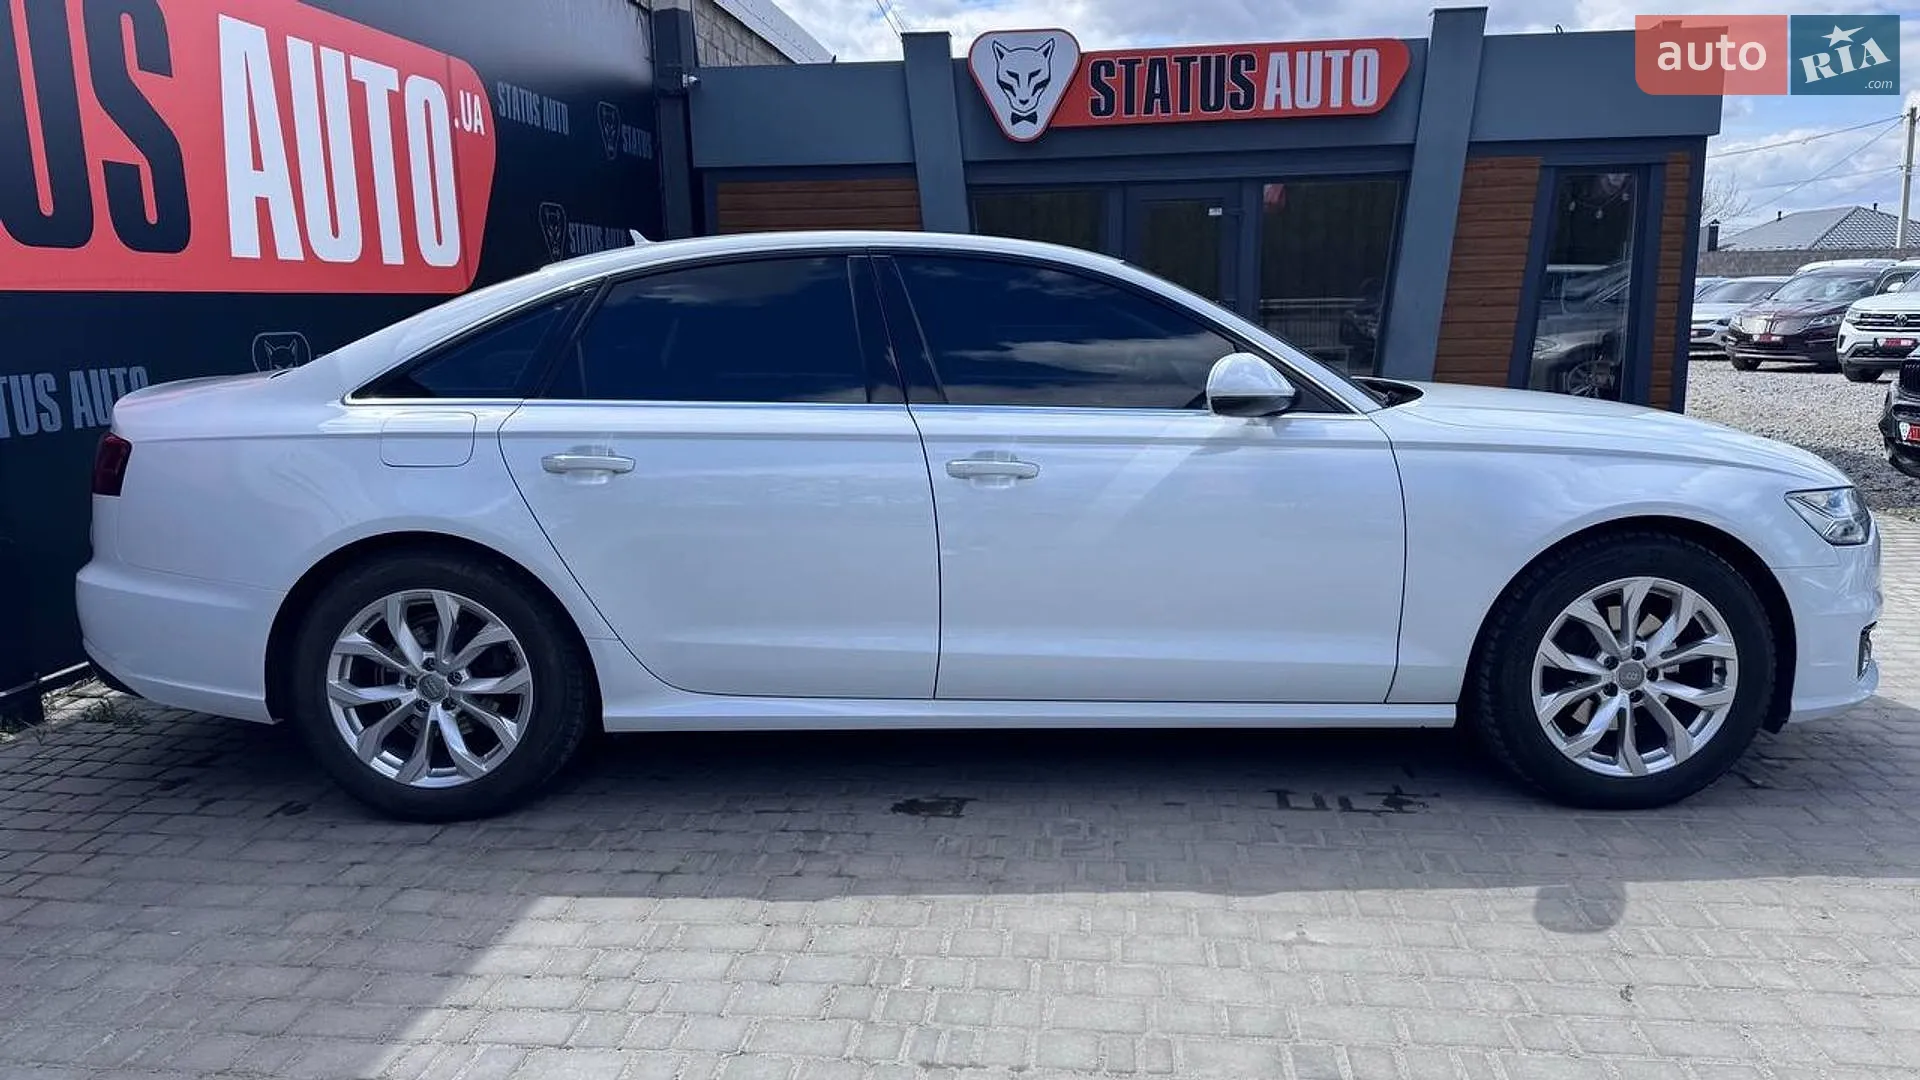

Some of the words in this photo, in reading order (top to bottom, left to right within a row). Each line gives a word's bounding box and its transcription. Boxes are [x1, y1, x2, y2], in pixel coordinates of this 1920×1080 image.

[497, 80, 541, 127] STATUS
[543, 96, 569, 135] AUTO
[1089, 52, 1257, 118] STATUS
[1263, 49, 1379, 110] AUTO
[218, 13, 461, 267] AUTO
